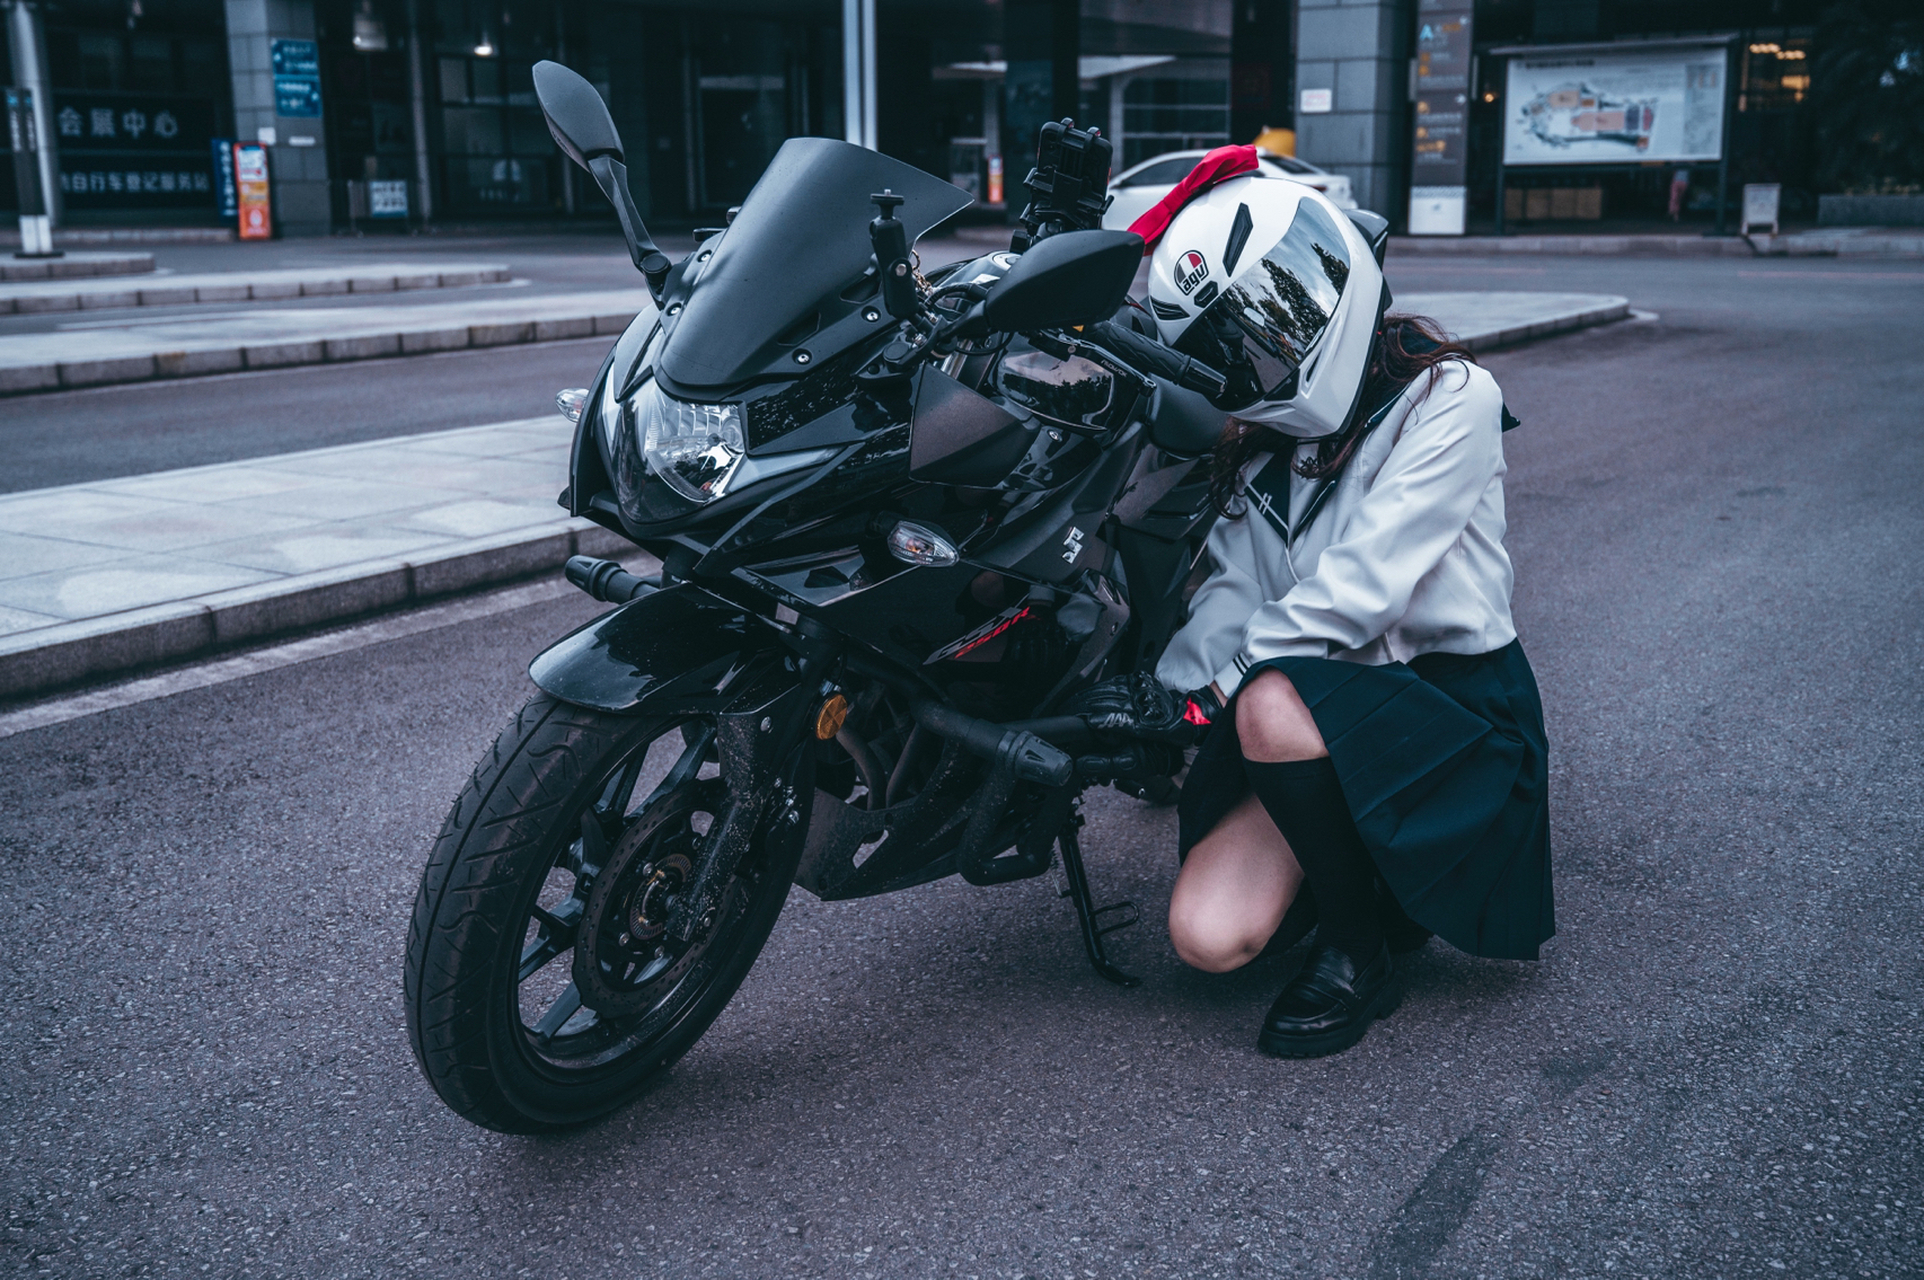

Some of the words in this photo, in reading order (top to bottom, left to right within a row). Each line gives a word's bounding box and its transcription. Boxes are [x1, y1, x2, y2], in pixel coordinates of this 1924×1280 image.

[58, 105, 178, 138] 会展中心
[1182, 263, 1205, 292] agv
